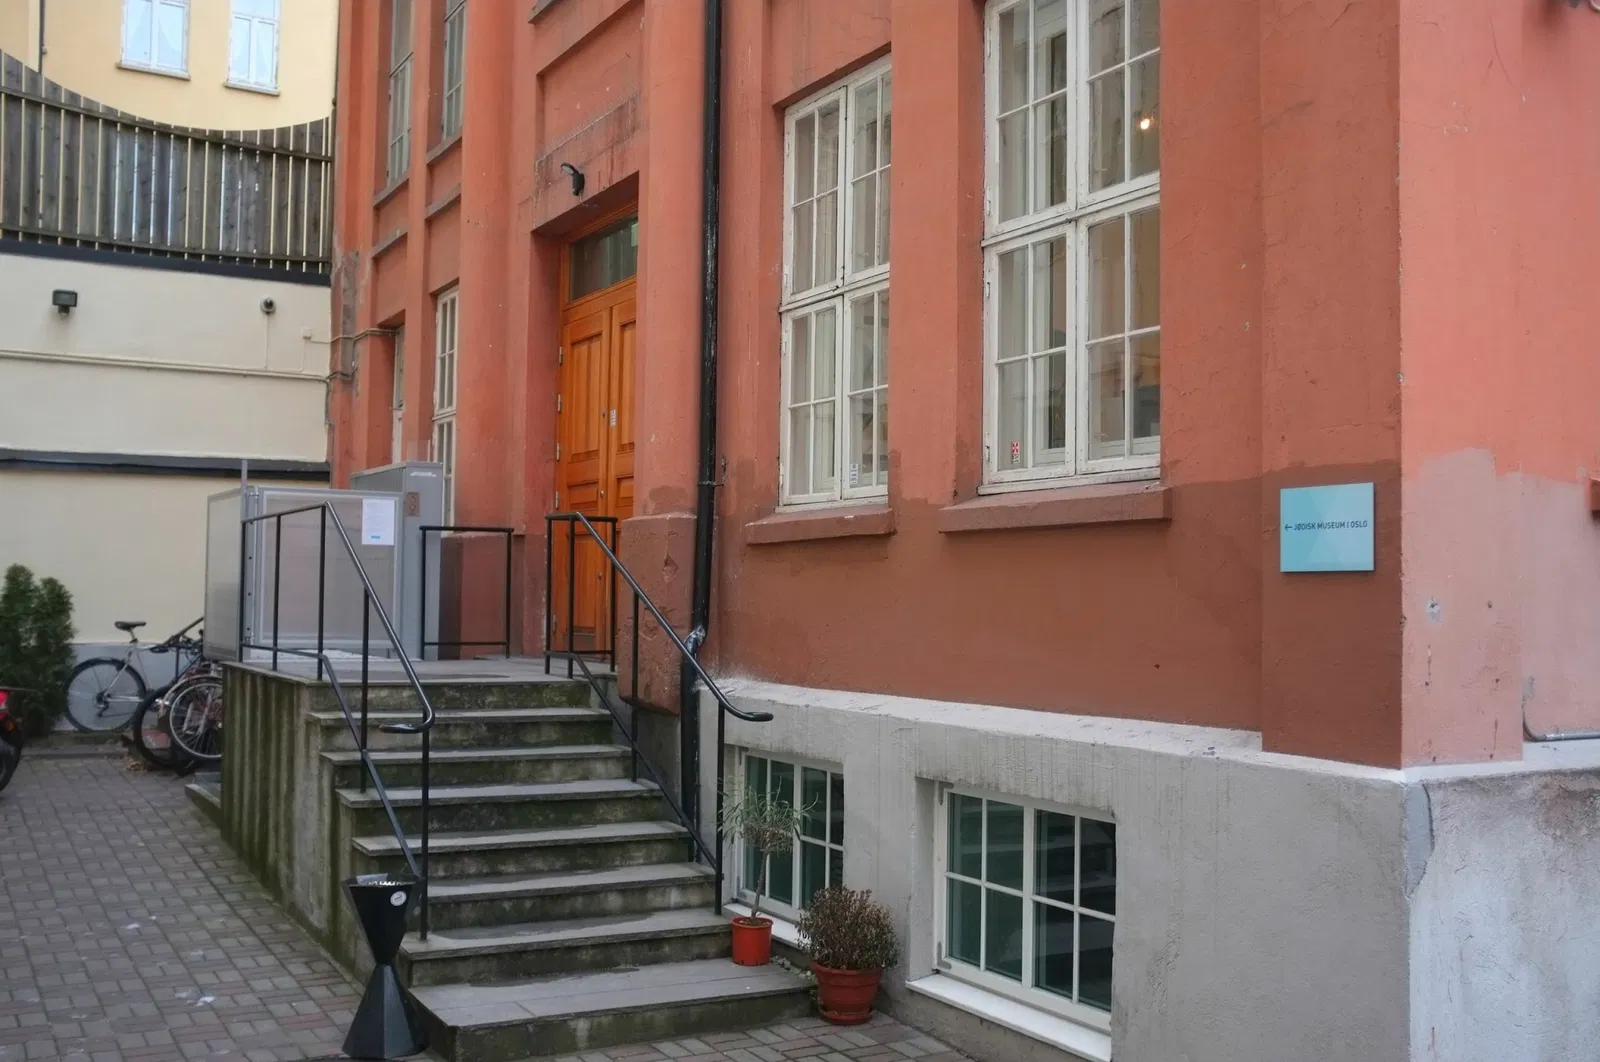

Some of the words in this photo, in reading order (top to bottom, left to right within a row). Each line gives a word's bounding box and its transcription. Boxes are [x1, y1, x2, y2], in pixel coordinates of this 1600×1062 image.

[1294, 522, 1316, 531] JØDISK
[1317, 521, 1345, 530] MUSEUM
[1351, 520, 1368, 528] OSLO
